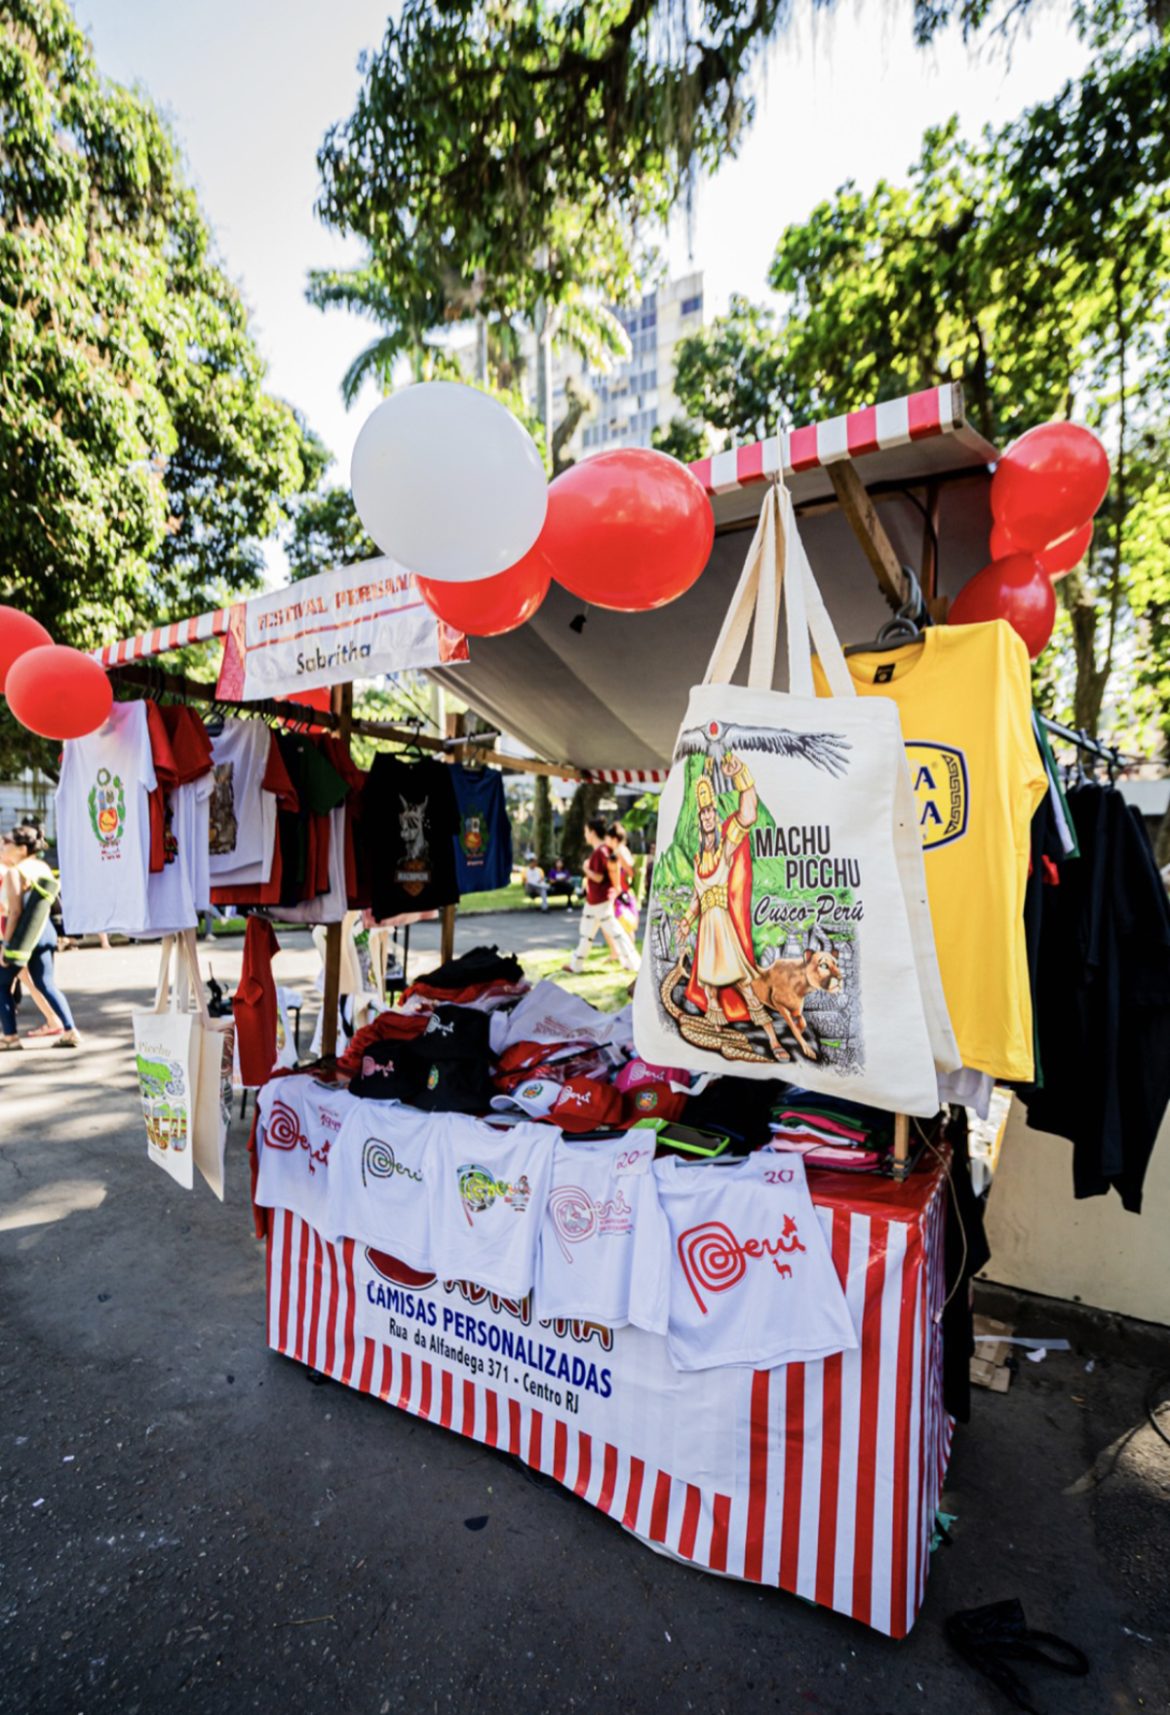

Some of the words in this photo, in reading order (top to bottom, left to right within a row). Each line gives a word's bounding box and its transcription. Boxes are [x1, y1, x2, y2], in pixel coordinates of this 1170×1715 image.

[258, 596, 328, 631] FESTIVAL
[296, 640, 372, 675] Sabritha
[755, 825, 831, 857] MACHU
[786, 858, 861, 889] PICCHU
[764, 1169, 795, 1184] 20
[366, 1280, 437, 1327] CAMISAS
[443, 1307, 613, 1398] PERSONALIZADAS
[389, 1318, 408, 1341] Rua
[414, 1329, 427, 1346] da
[429, 1337, 484, 1375] Alfandega
[488, 1361, 509, 1384] 371
[523, 1373, 562, 1407] Centro
[566, 1391, 579, 1414] RJ
